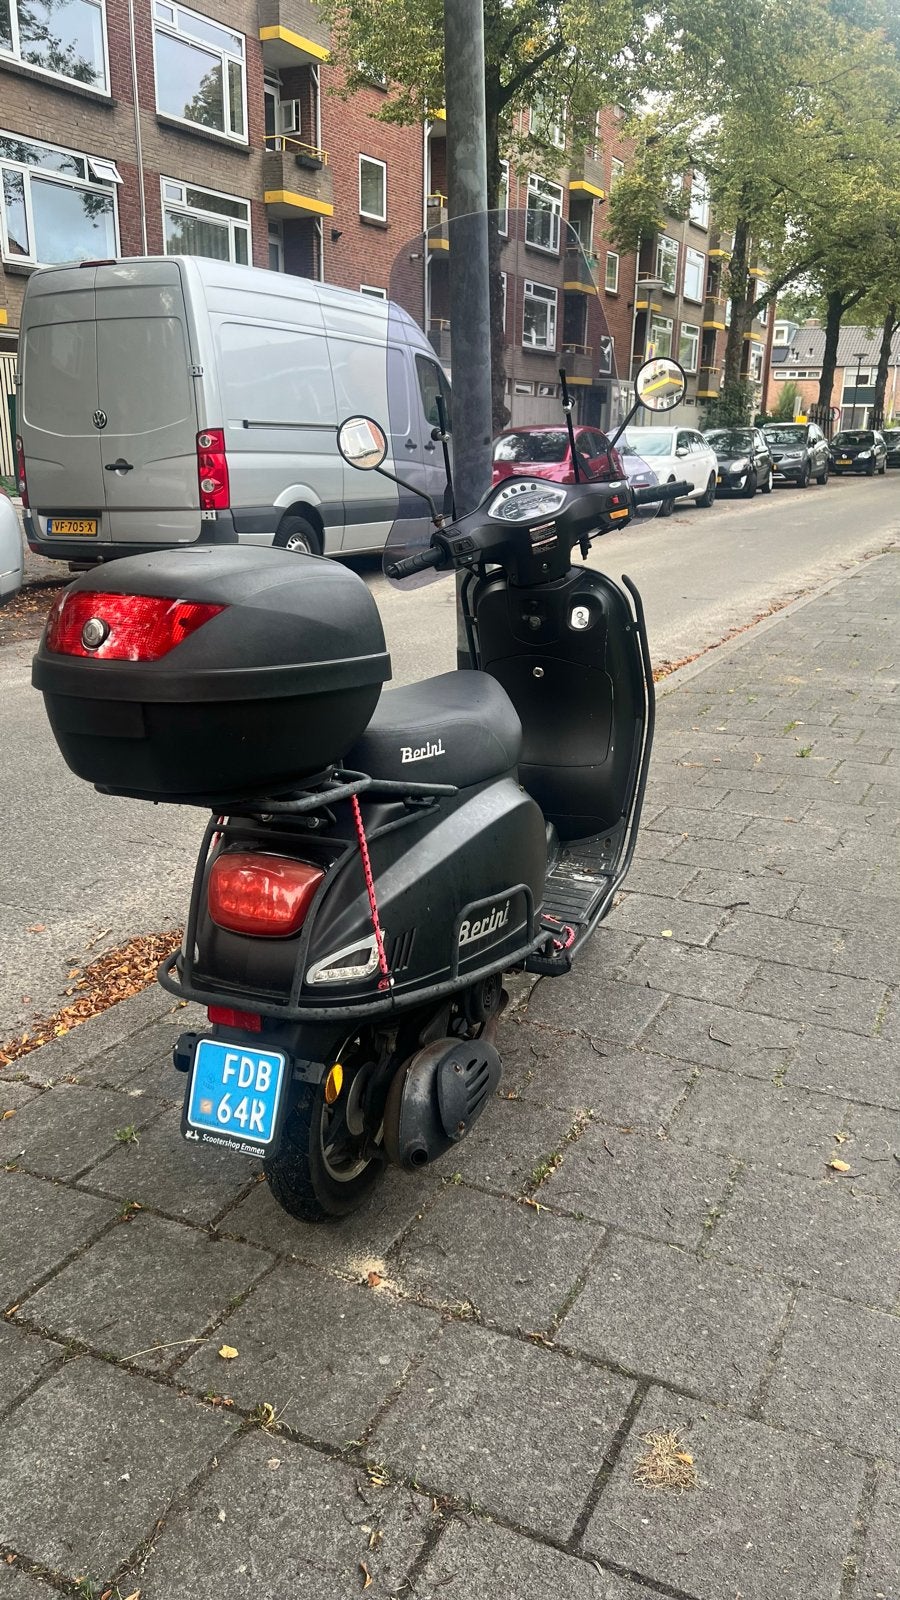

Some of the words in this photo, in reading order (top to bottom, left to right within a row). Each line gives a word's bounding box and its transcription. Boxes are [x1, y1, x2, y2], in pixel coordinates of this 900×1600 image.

[54, 521, 93, 532] VF-705-X
[400, 738, 446, 764] Berini
[458, 900, 510, 947] Berini
[221, 1053, 272, 1092] FDB
[217, 1092, 266, 1133] 64R
[202, 1133, 240, 1150] Scootershop
[240, 1142, 265, 1156] Emmen
